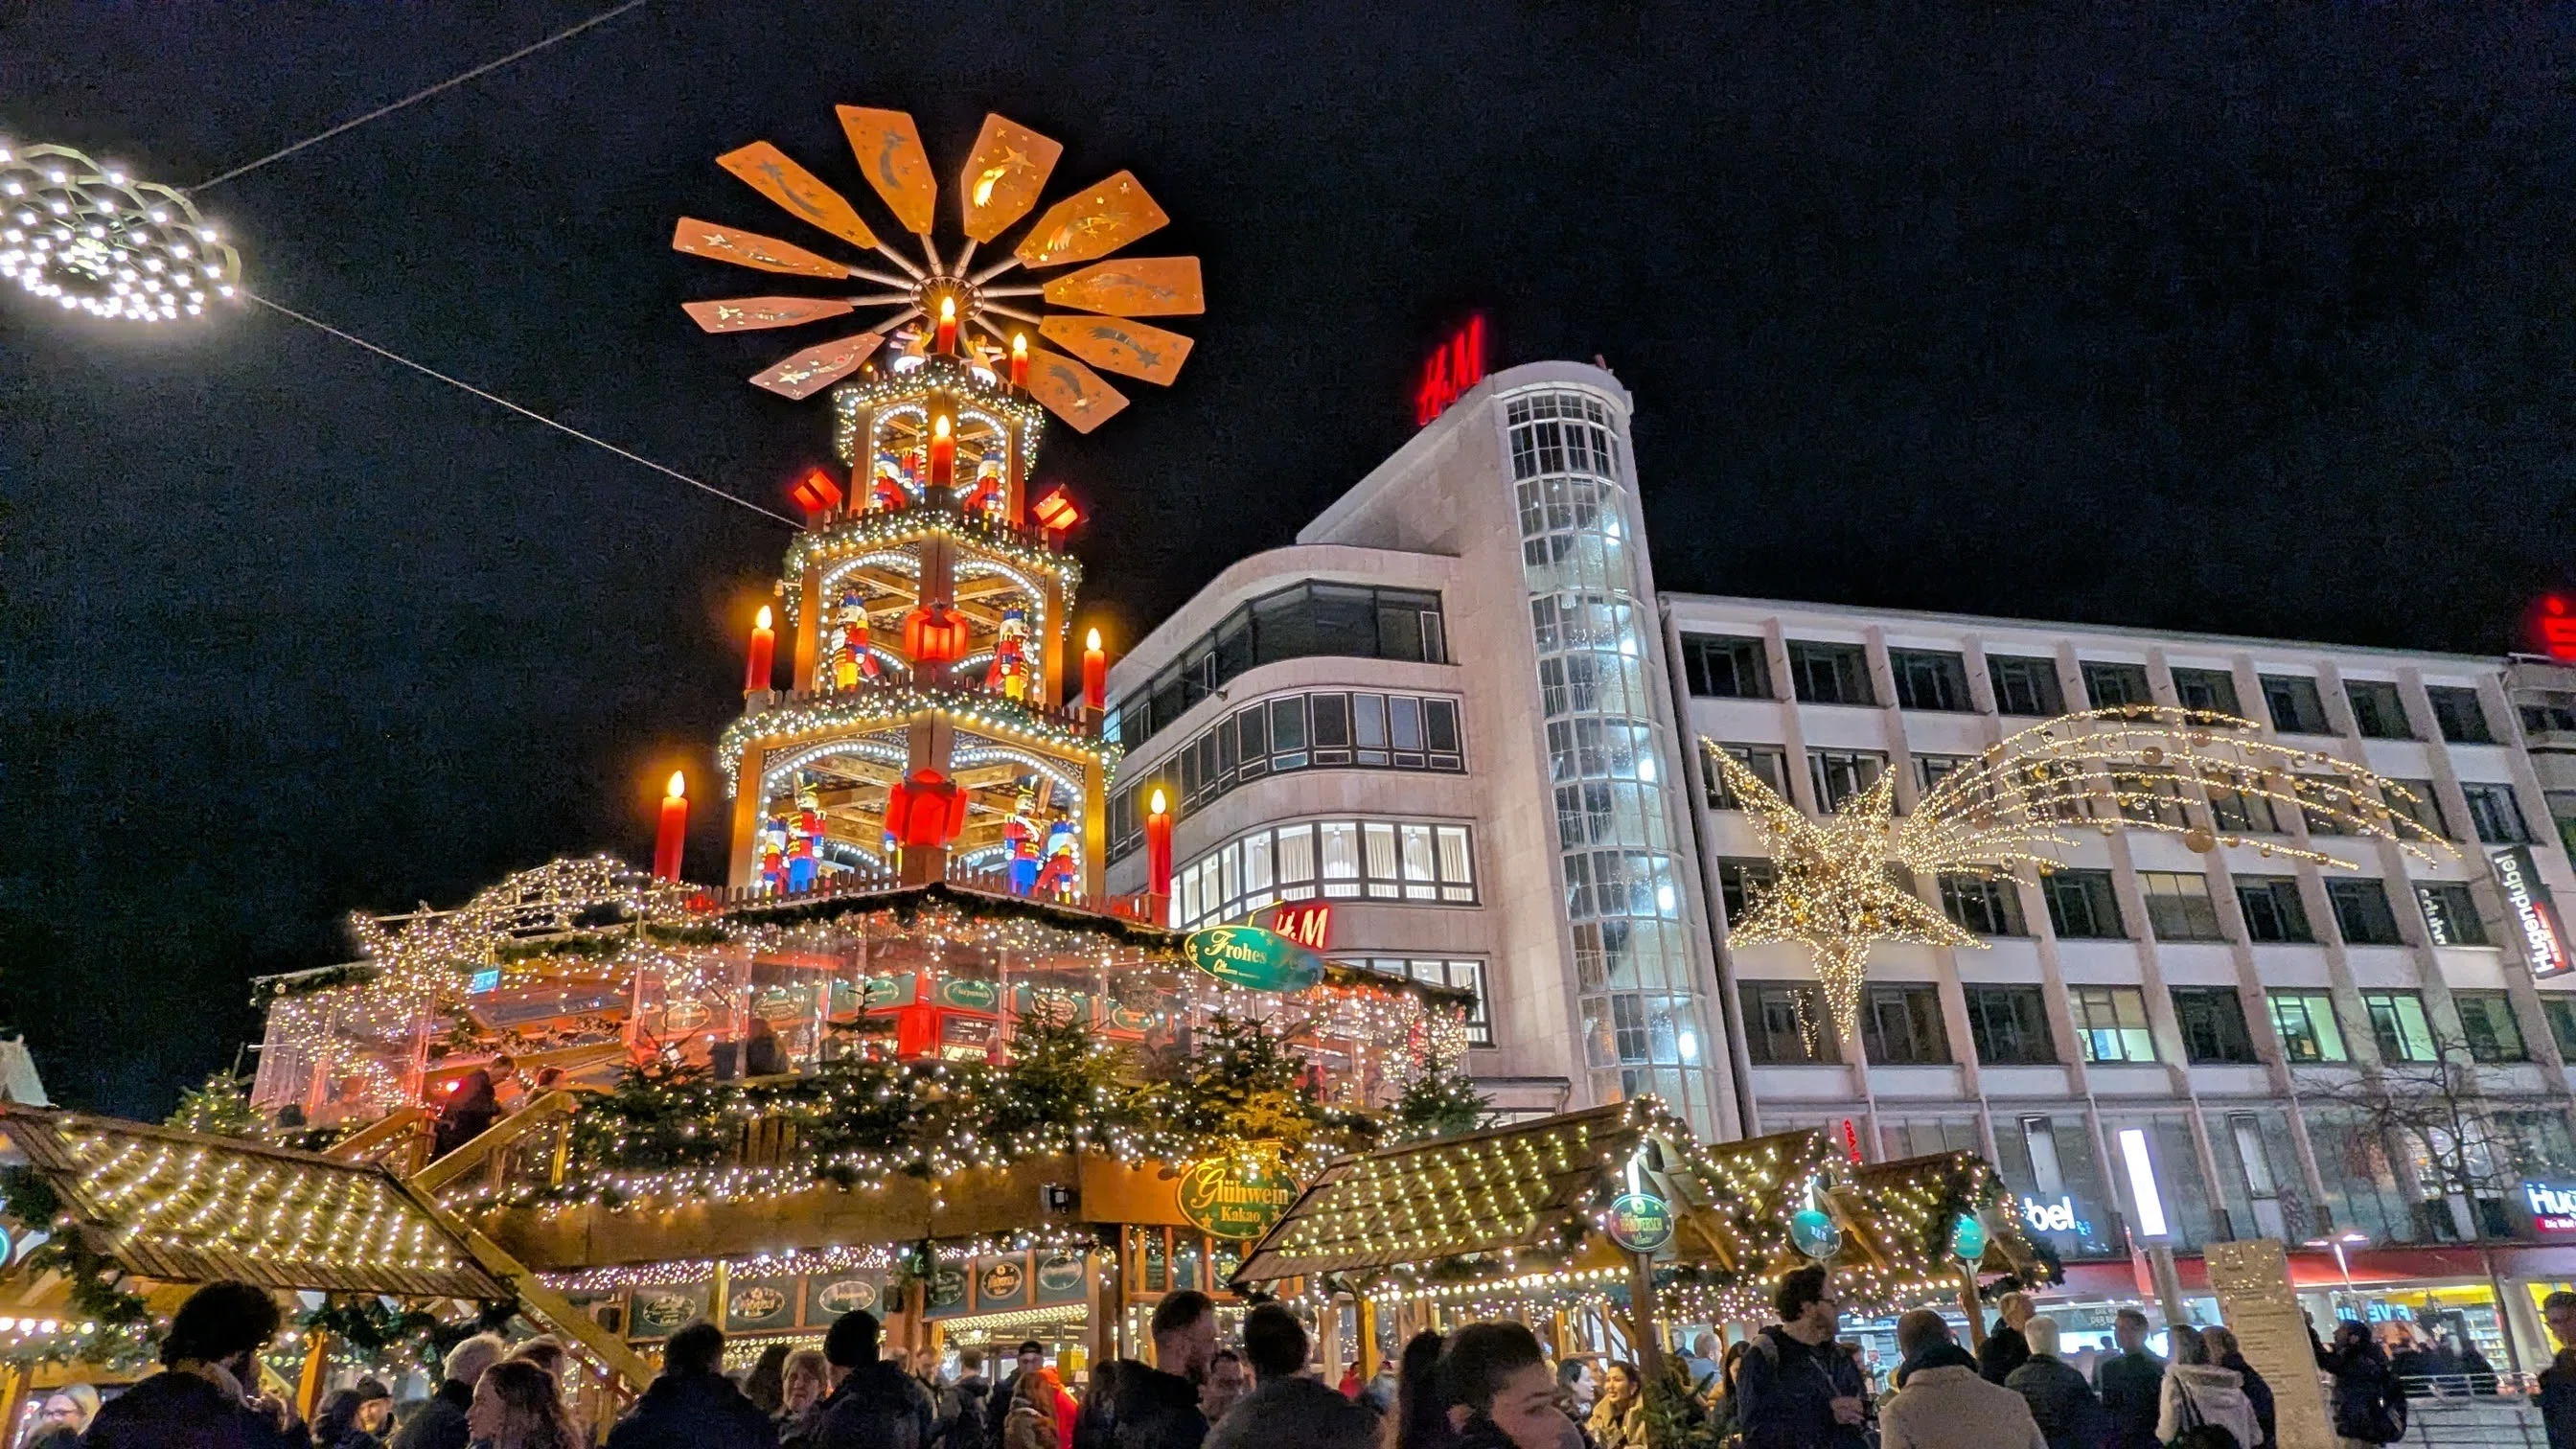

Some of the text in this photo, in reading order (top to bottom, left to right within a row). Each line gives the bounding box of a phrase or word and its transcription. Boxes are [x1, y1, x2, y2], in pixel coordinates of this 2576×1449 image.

[2495, 854, 2555, 973] Hugendubel
[1205, 931, 1267, 964] Frohes
[1190, 1166, 1289, 1208] Glühwein
[1221, 1206, 1260, 1222] Kakao
